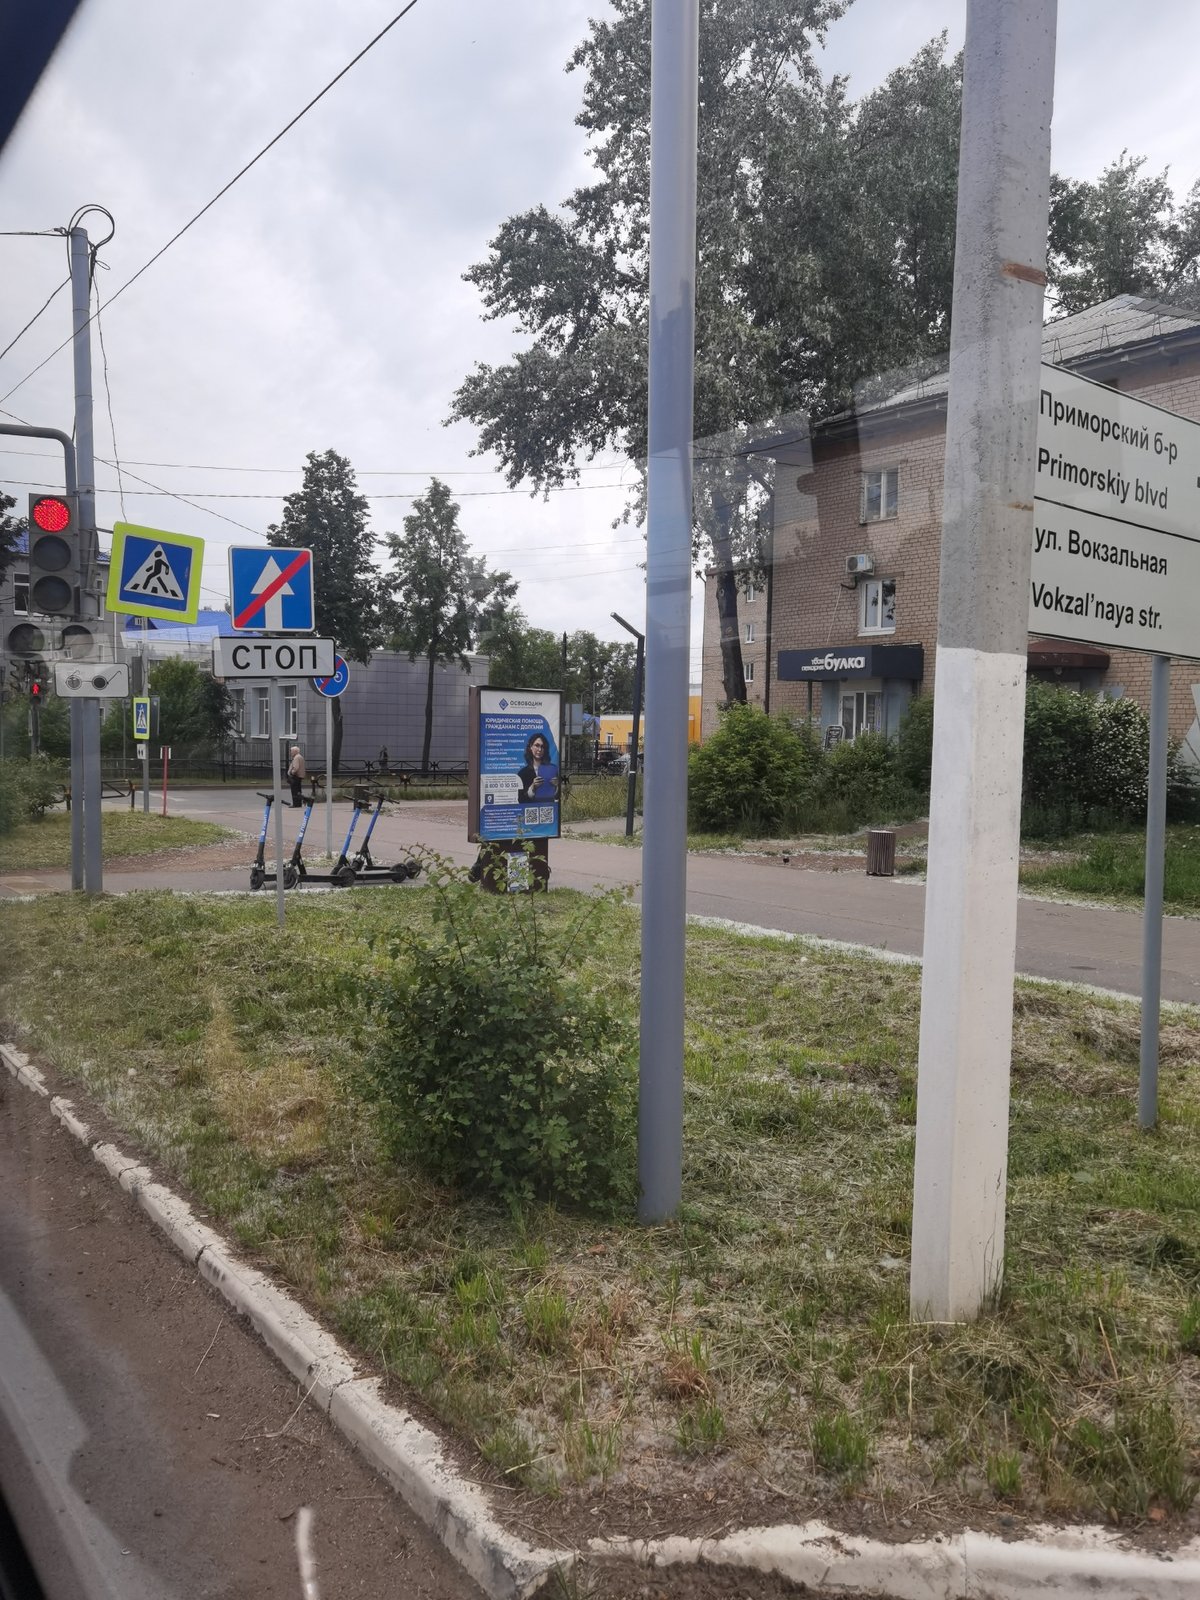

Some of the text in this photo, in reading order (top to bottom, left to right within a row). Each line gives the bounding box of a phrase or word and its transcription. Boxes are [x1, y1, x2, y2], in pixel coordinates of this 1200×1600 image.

[1040, 389, 1178, 465] Приморский б-р
[1038, 447, 1168, 510] Primorskiy blvd
[1034, 527, 1168, 576] ул. Вокзальная
[1031, 582, 1163, 630] Vokzal'naya str.
[232, 645, 317, 670] СТОП
[824, 653, 866, 671] булка
